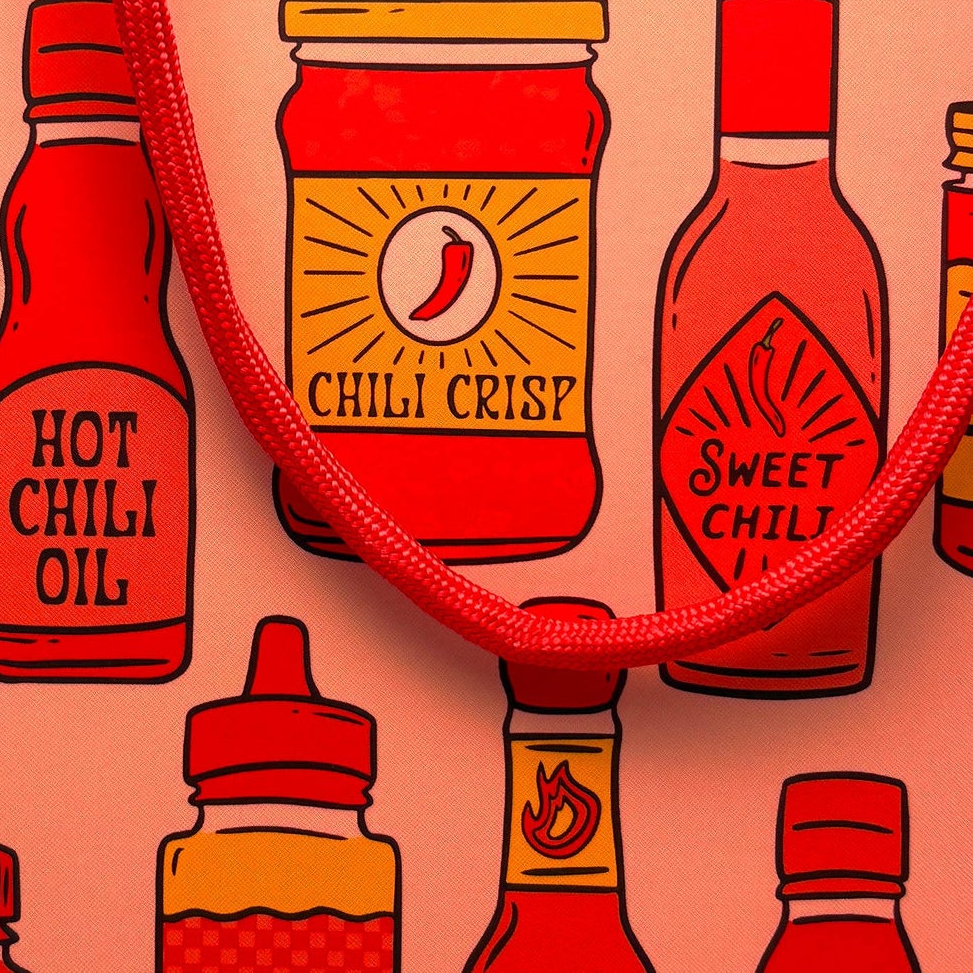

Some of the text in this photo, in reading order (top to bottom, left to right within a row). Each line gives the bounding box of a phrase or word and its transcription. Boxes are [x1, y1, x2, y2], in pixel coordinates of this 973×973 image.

[308, 371, 577, 421] CHILI CRISP
[31, 409, 138, 468] HOT
[688, 438, 845, 497] SWEET
[9, 477, 158, 538] CHILI
[701, 503, 835, 542] CHILI
[35, 547, 129, 607] OIL
